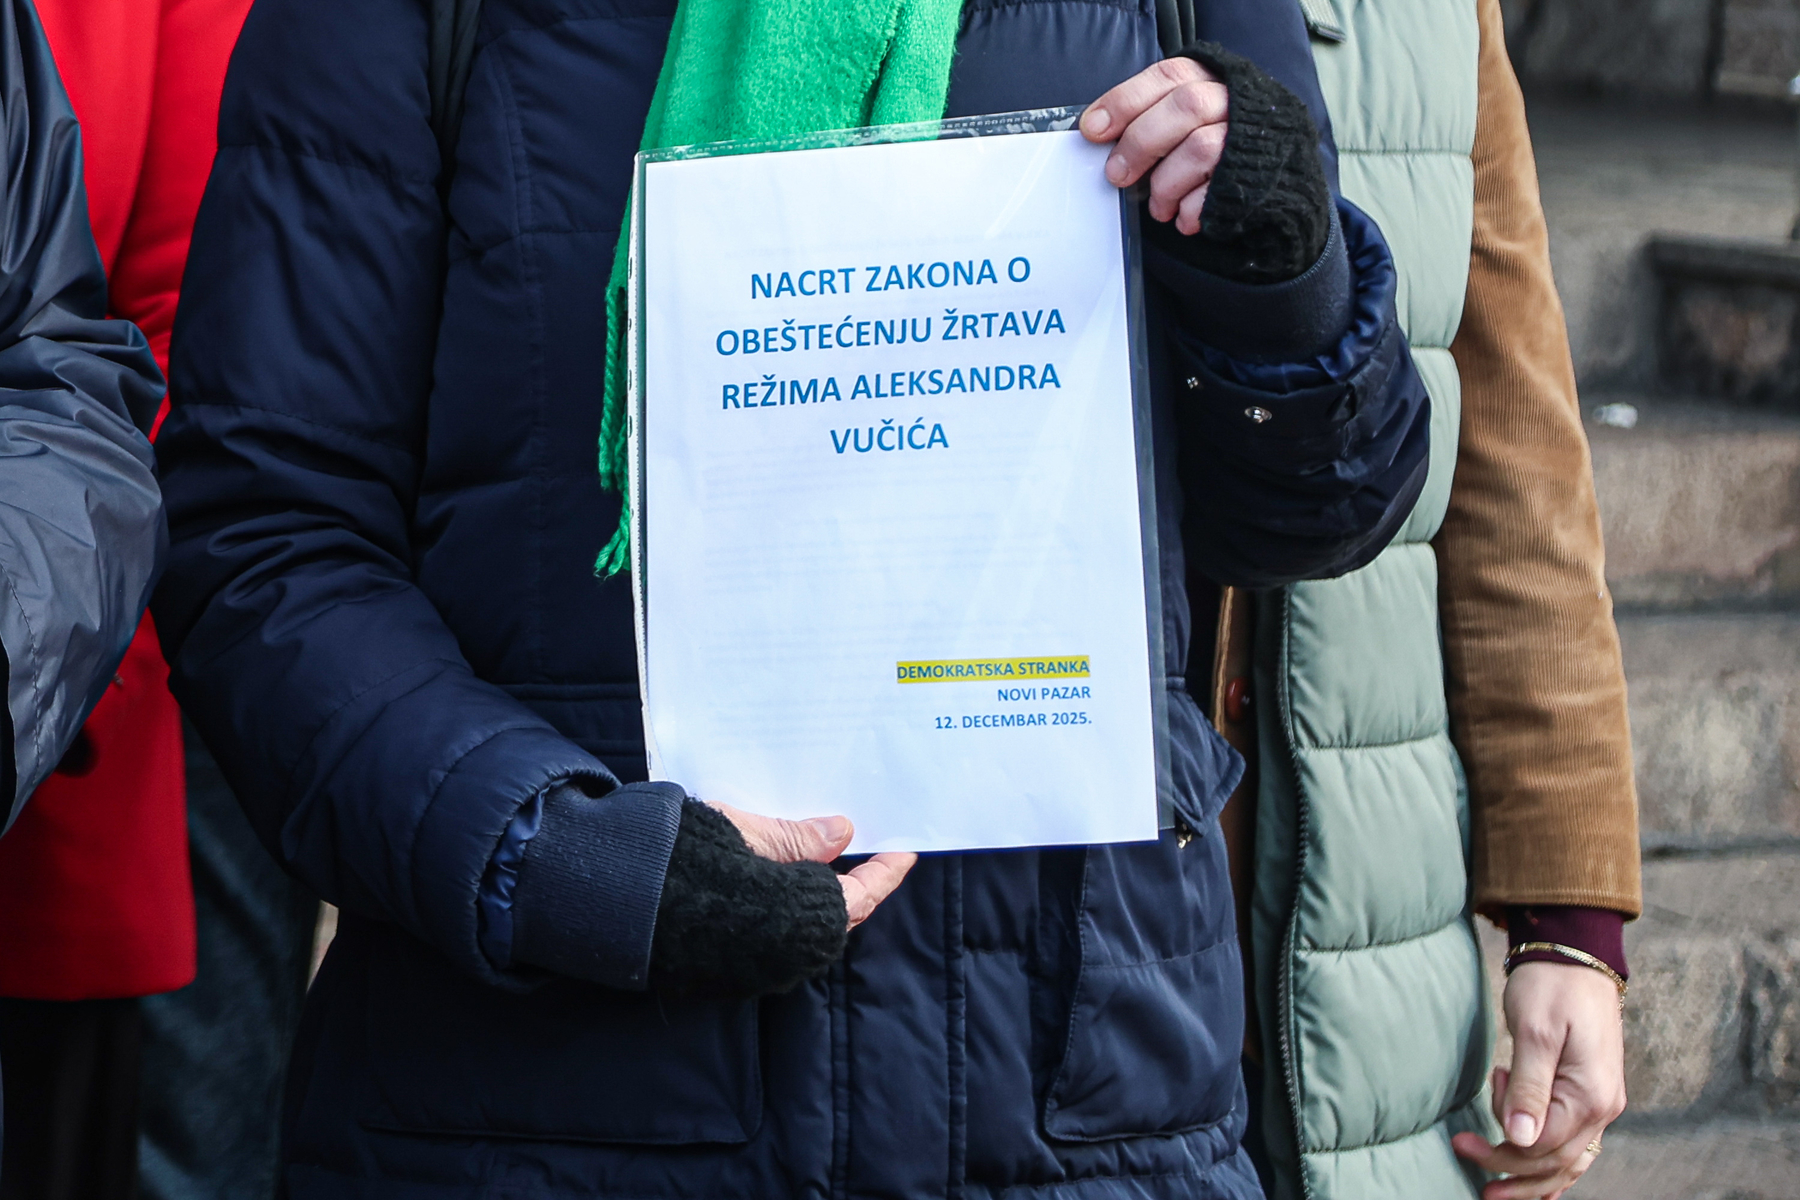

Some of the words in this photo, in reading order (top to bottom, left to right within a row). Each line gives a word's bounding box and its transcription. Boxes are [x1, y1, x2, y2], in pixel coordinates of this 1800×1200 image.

[751, 267, 855, 300] NACRT
[865, 259, 998, 292] ZAKONA
[1007, 256, 1031, 282] O
[716, 315, 932, 356] OBEŠTEĆENJU
[941, 308, 1066, 341] ŽRTAVA
[722, 374, 841, 410] REŽIMA
[850, 363, 1061, 400] ALEKSANDRA
[830, 417, 949, 453] VUČIĆA
[897, 664, 1014, 680] DEMOKRATSKA
[1018, 660, 1090, 675] STRANKA
[997, 688, 1036, 701] NOVI
[1041, 686, 1091, 700] PAZAR
[935, 716, 957, 729] 12.
[962, 713, 1047, 728] DECEMBAR
[1052, 712, 1092, 725] 2025.
